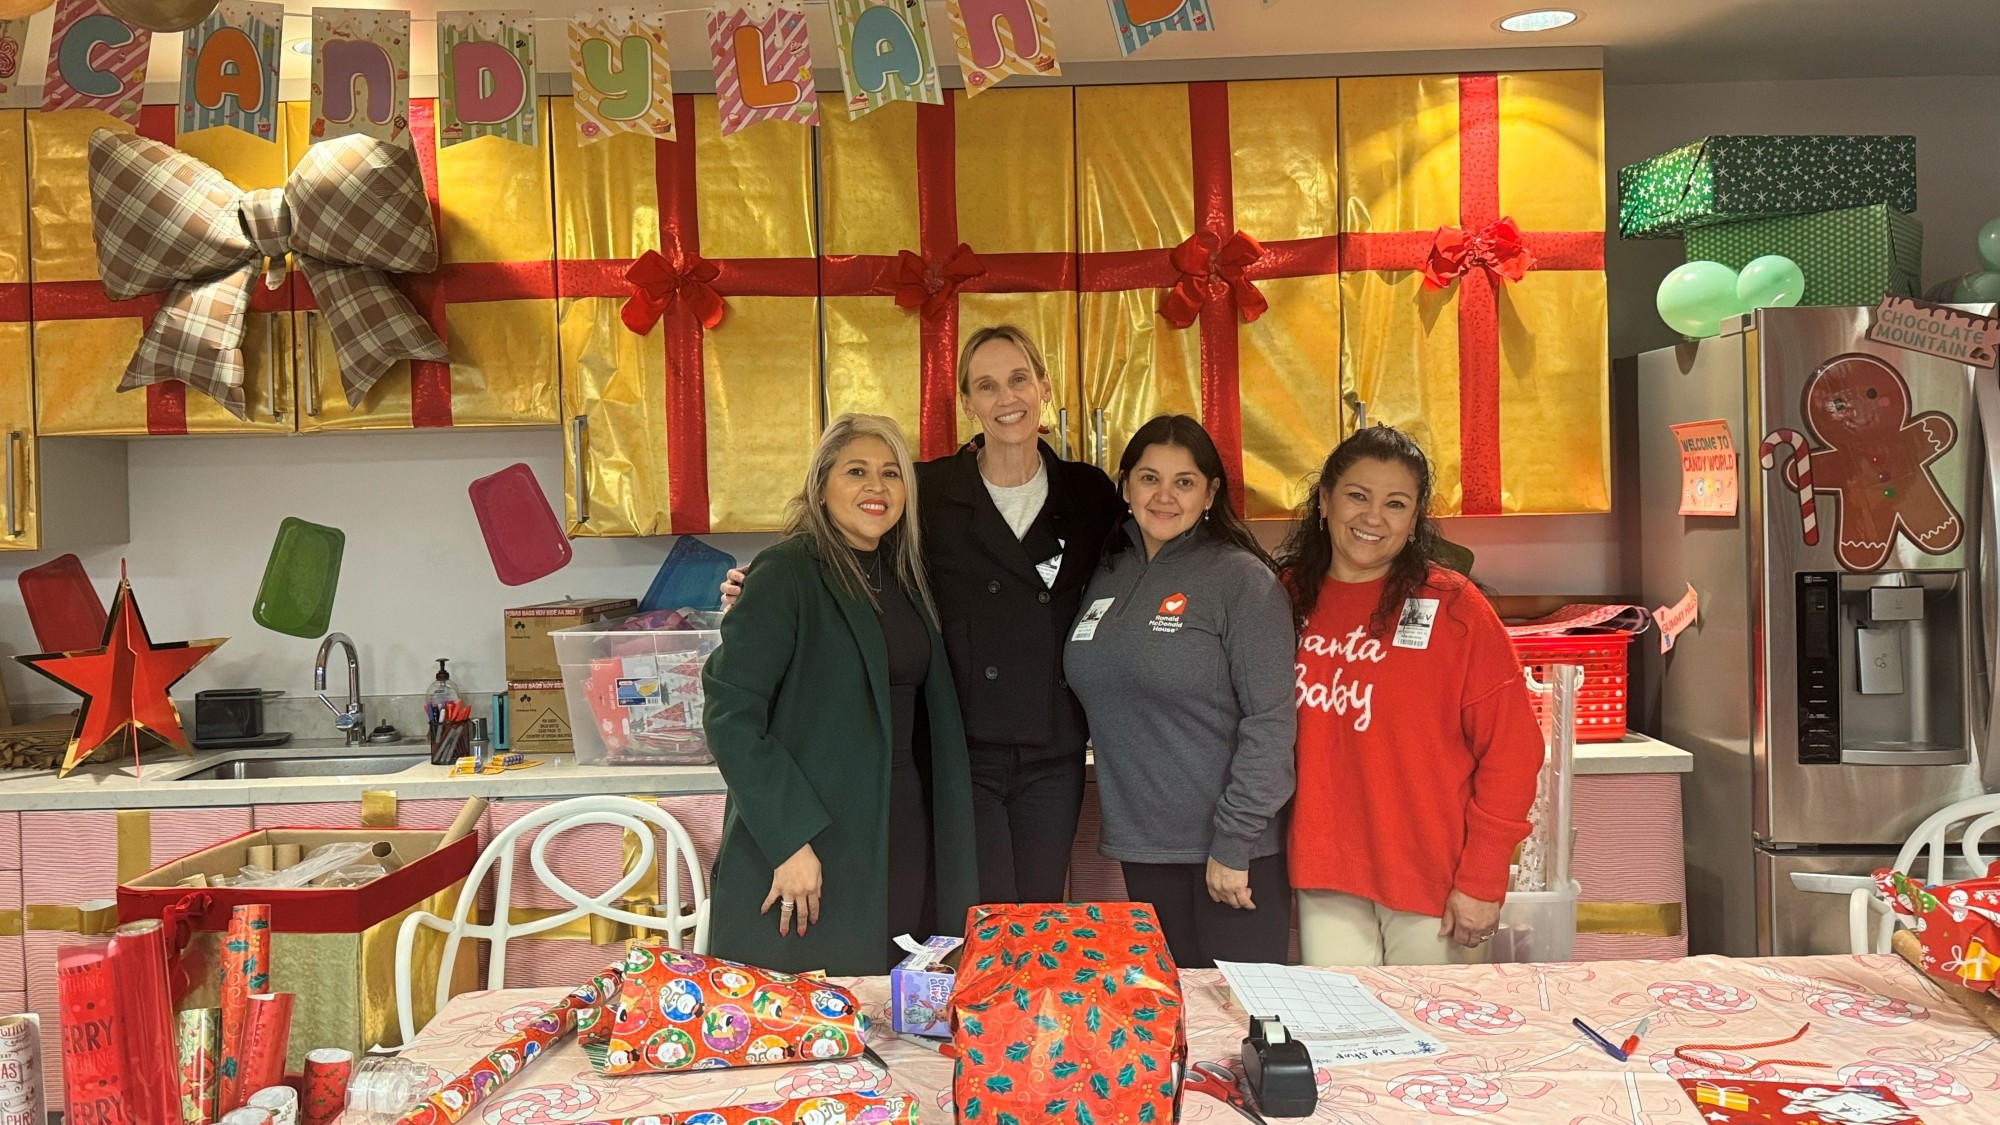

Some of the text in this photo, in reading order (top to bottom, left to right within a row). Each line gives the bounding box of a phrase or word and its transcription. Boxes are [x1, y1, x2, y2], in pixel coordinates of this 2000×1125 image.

[1881, 309, 1986, 345] CHOCOLATE
[1875, 324, 1968, 358] MOUNTAIN
[1681, 435, 1730, 452] WELCOME TO
[1683, 454, 1734, 472] CANDY WORLD
[1148, 619, 1184, 628] McDonald
[1155, 614, 1180, 622] Ronald
[1661, 610, 1685, 635] GUMMY
[1298, 616, 1387, 663] anta
[929, 978, 940, 1003] alive
[938, 978, 950, 1004] baby
